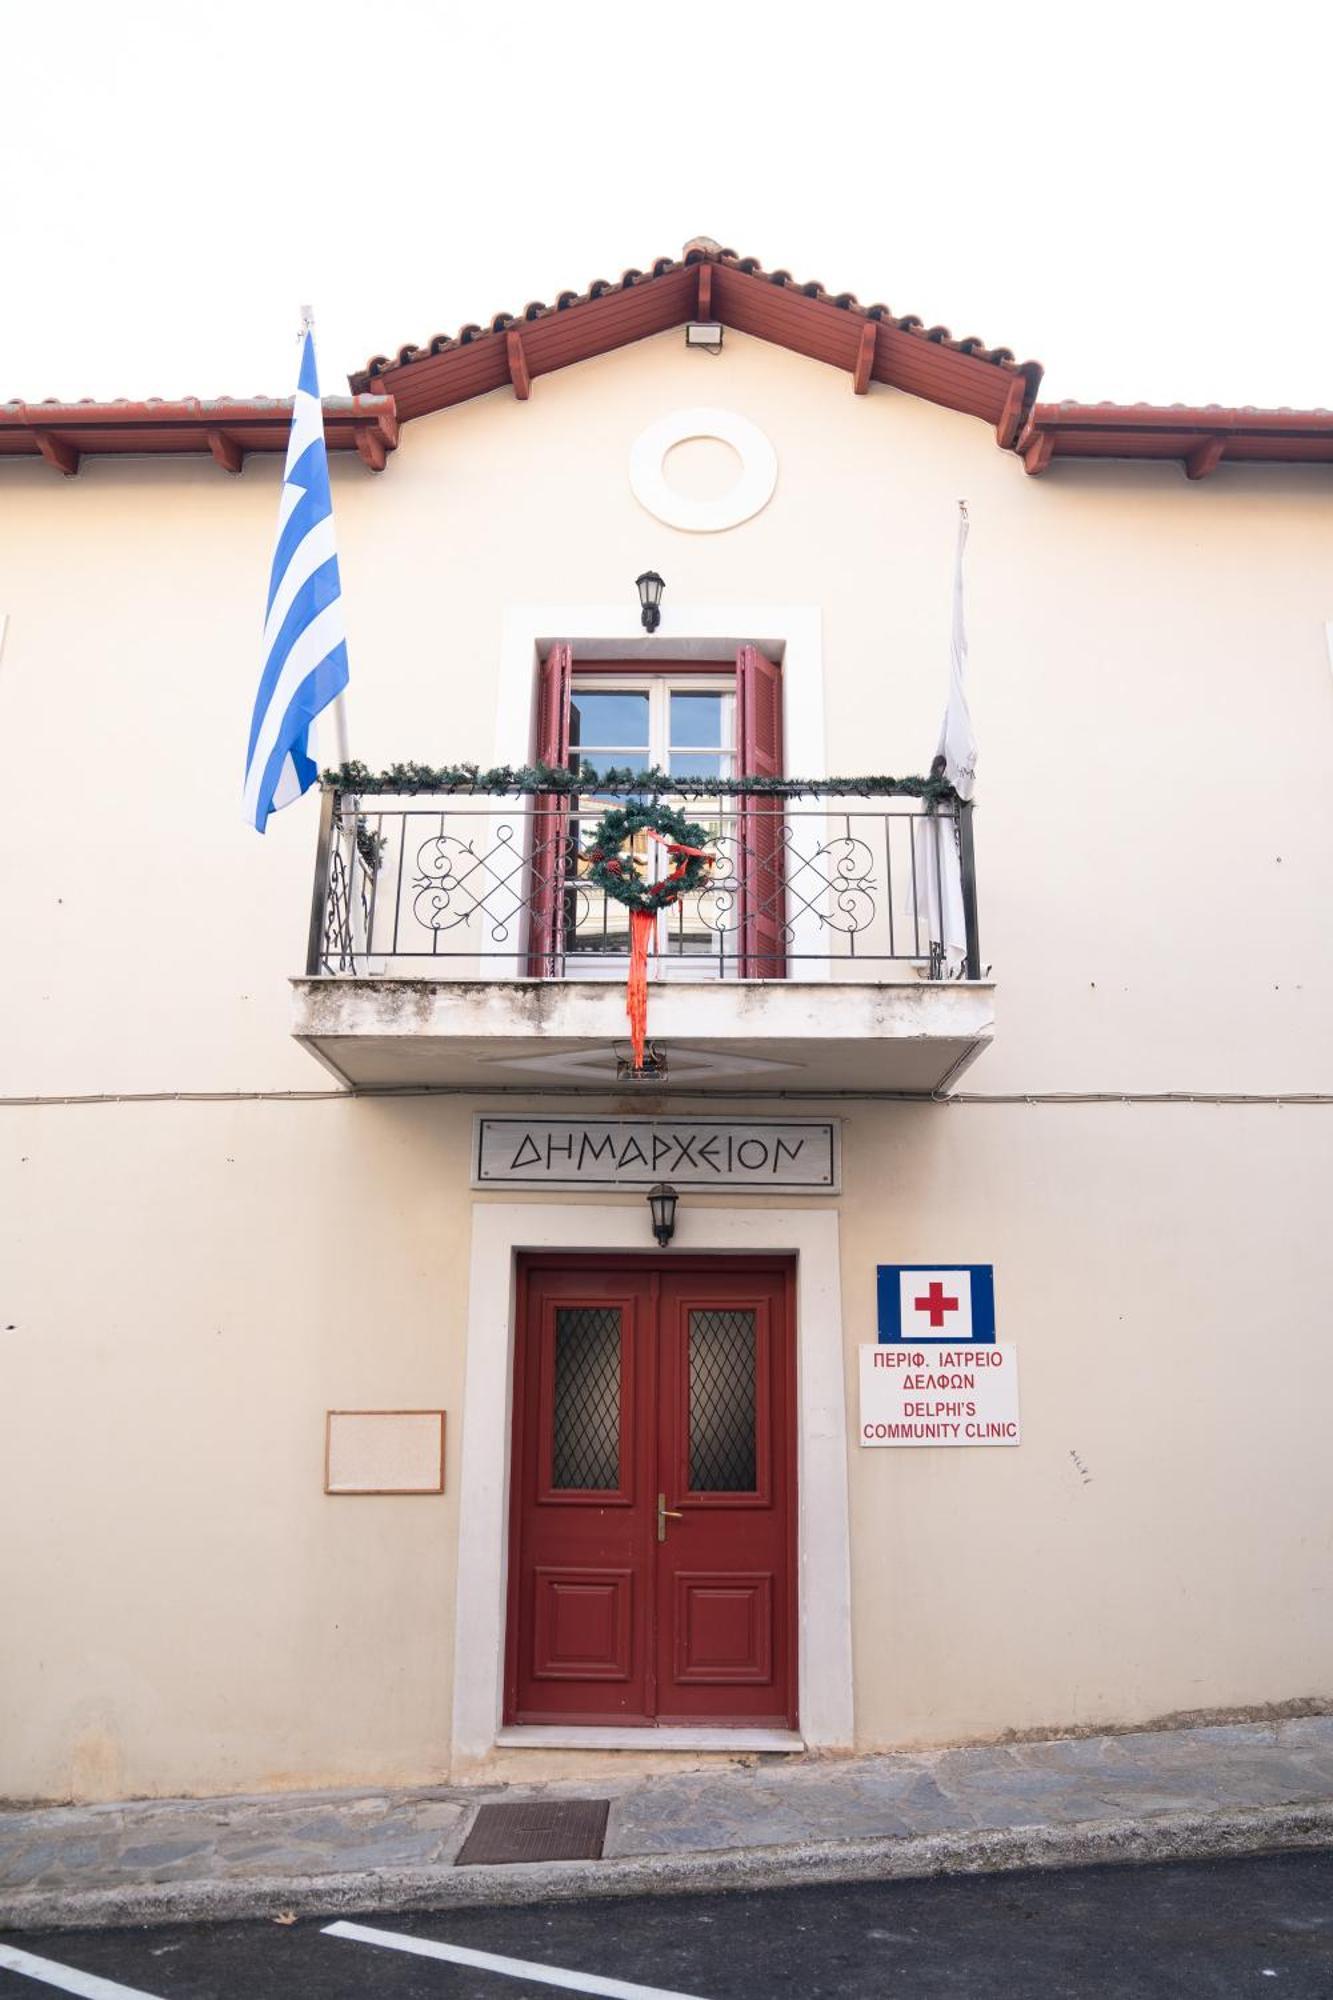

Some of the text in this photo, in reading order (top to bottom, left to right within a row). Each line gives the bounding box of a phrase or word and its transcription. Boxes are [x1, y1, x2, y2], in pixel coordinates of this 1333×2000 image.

[510, 1131, 805, 1174] ΔΗΜΑΡΧΕΙΟΝ
[873, 1351, 1003, 1368] ΠΕΡΙΦ. ΙΑΤΡΕΙΟ
[903, 1374, 975, 1390] ΔΕΛΦΩΝ
[904, 1402, 976, 1417] DELPHI'S
[863, 1422, 1017, 1438] COMMUNITY CLINIC
